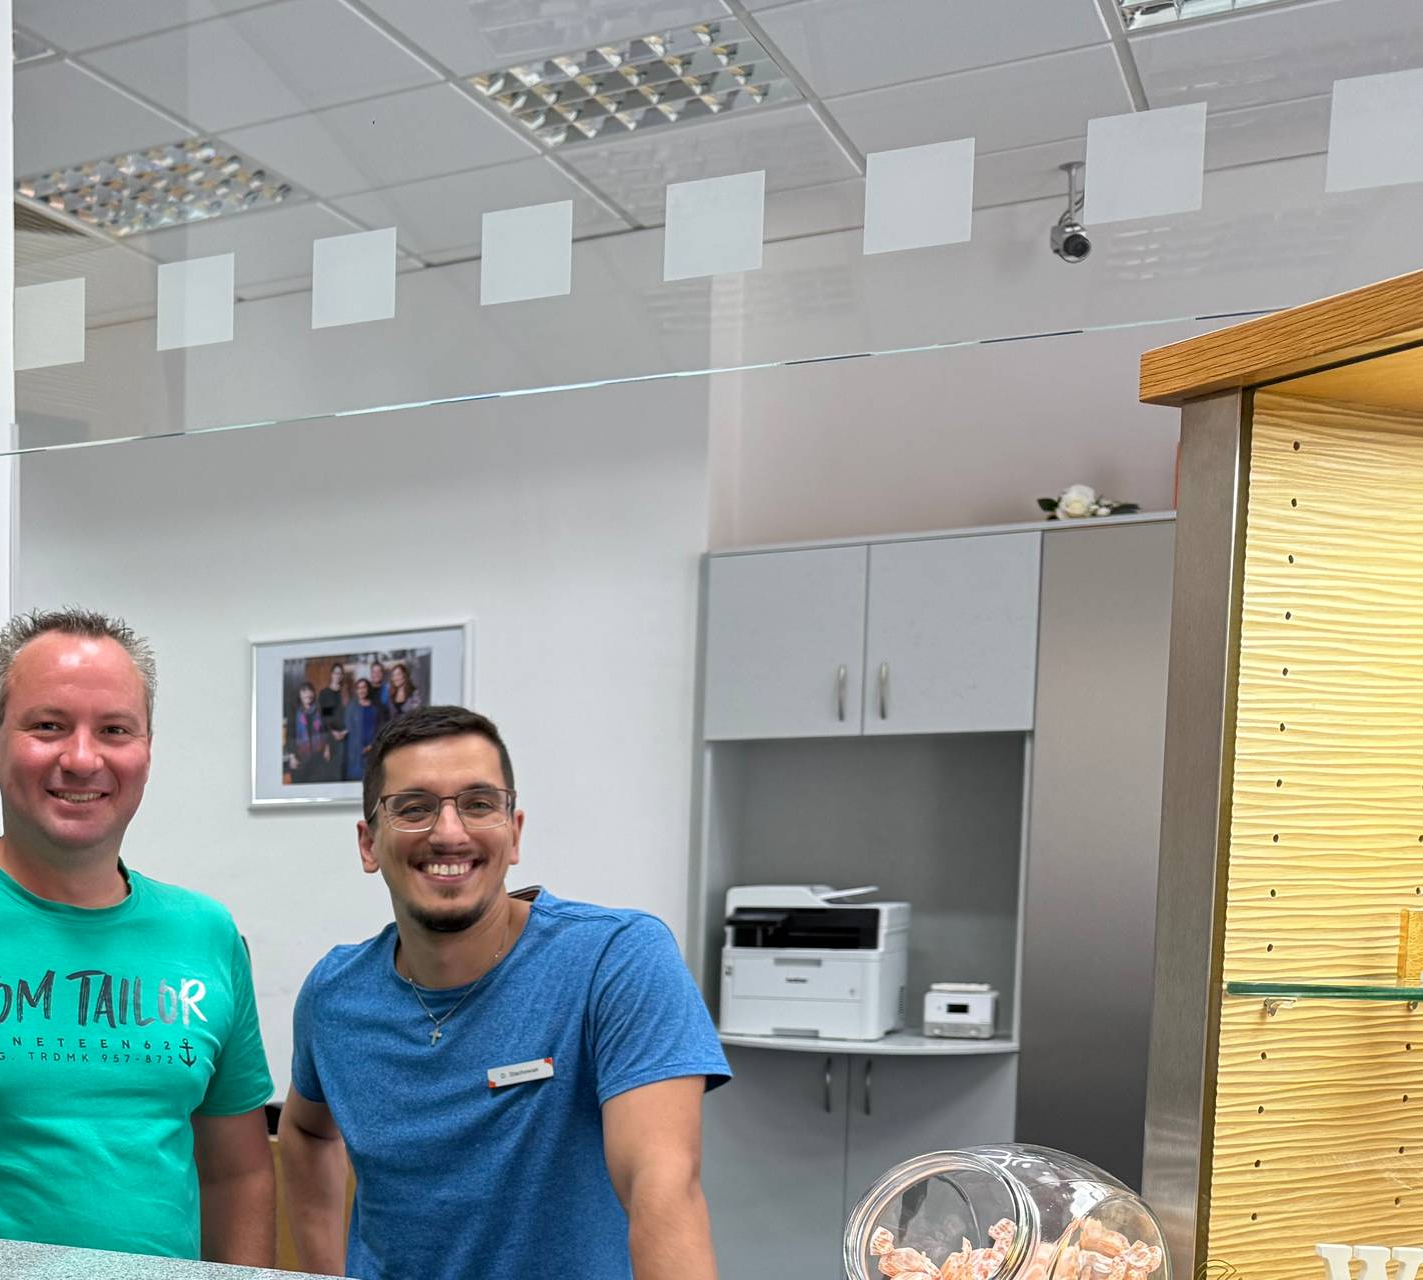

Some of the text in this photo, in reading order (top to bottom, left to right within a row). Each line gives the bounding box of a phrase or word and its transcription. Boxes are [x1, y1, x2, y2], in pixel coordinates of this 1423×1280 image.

[66, 970, 208, 1029] TAILOR
[28, 1052, 89, 1062] TRDMK
[101, 1053, 173, 1065] 957-872
